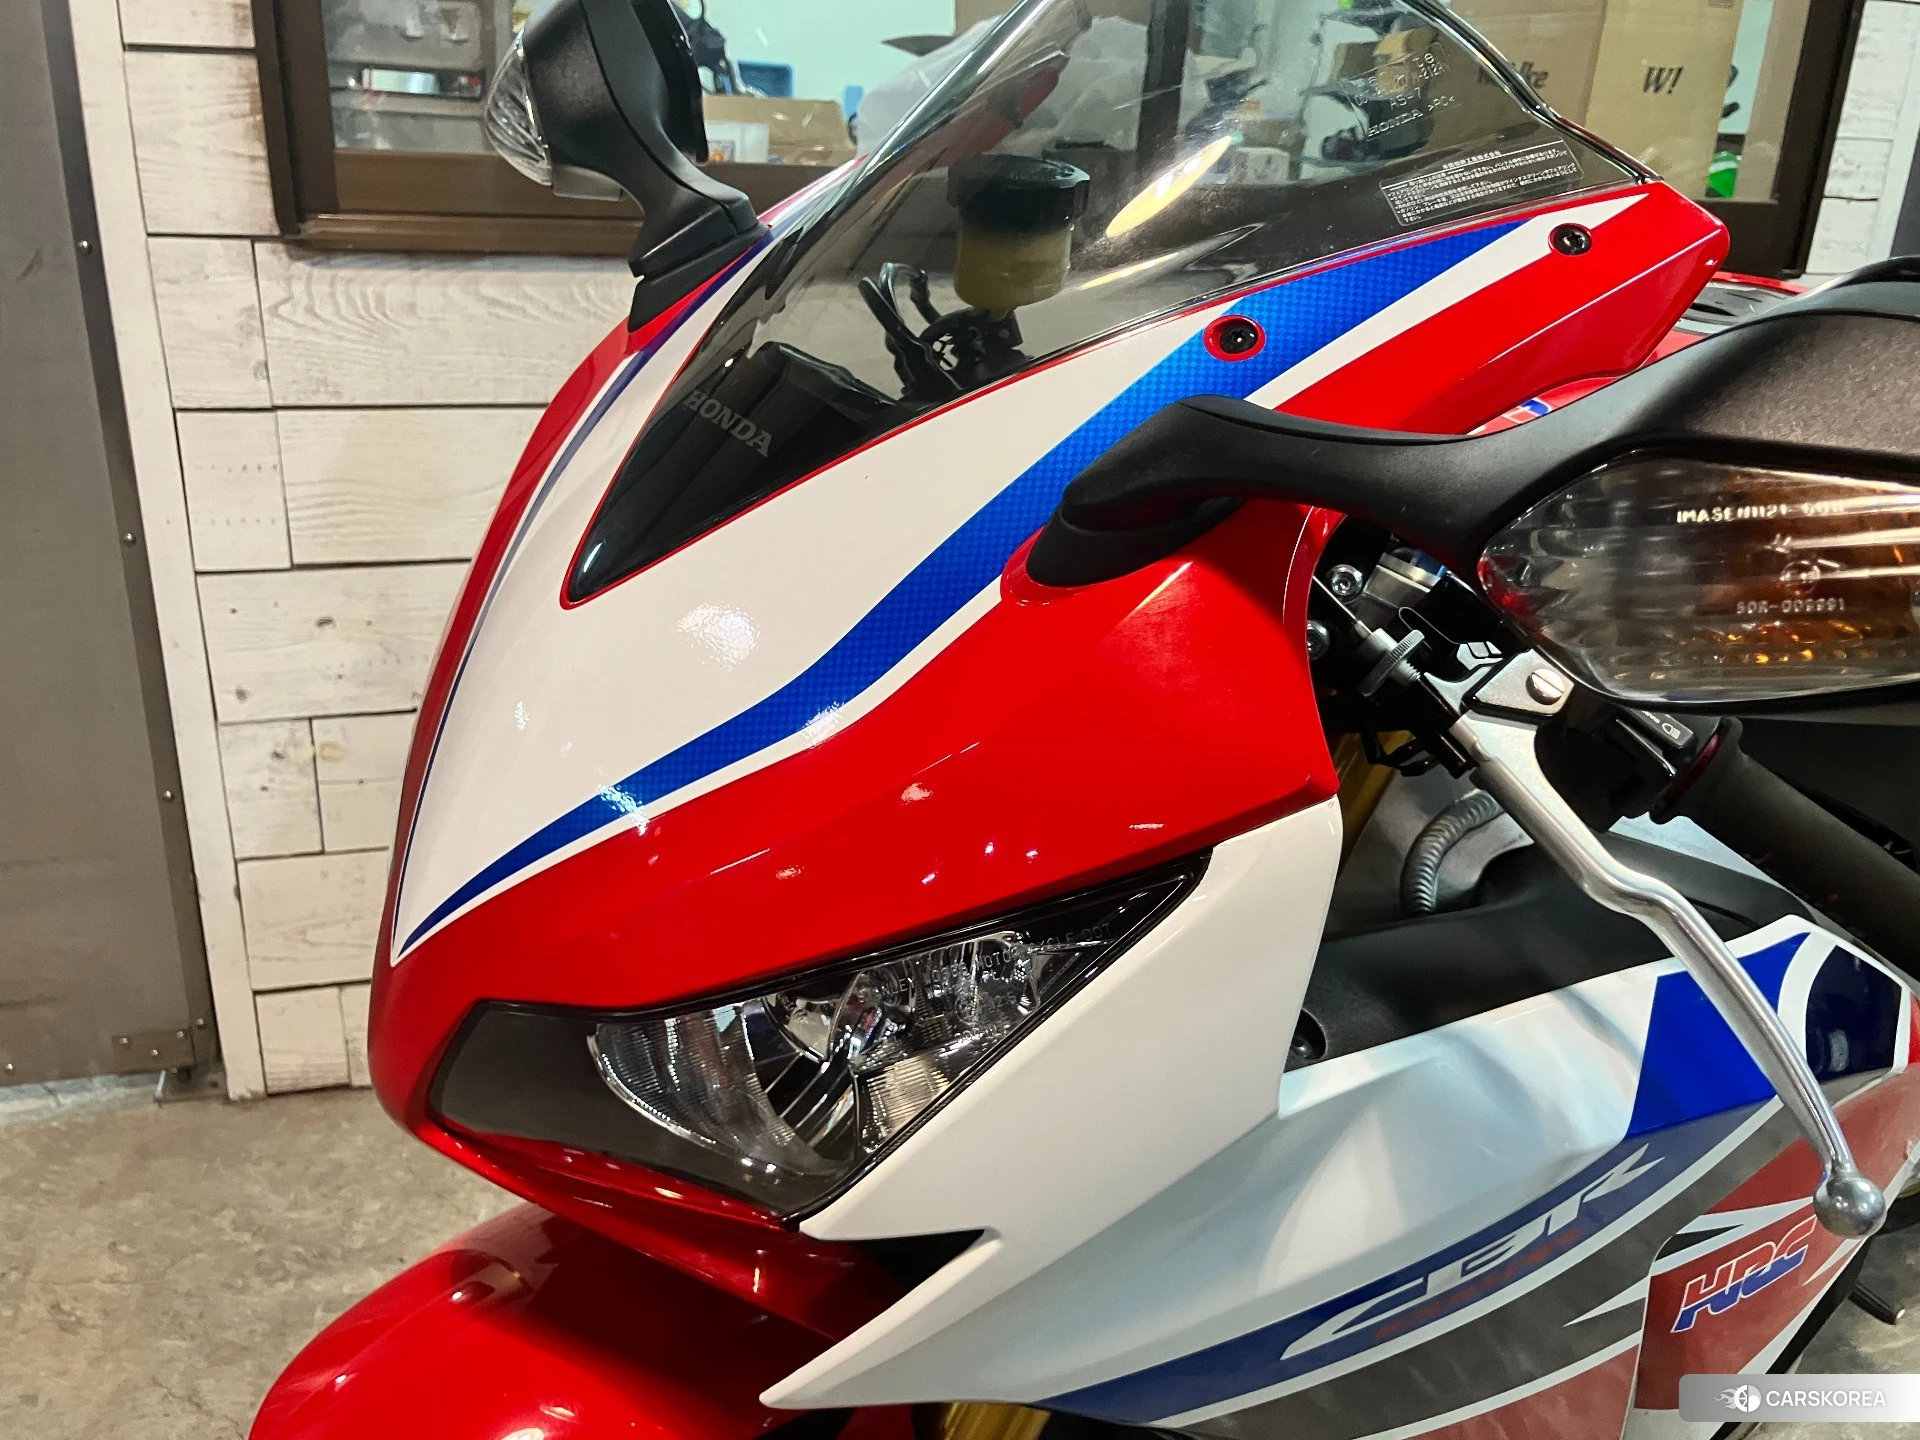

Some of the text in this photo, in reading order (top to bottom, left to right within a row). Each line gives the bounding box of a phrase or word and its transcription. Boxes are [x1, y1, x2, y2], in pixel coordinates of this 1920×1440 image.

[1641, 65, 1684, 96] W!
[682, 389, 772, 458] HONDA
[1279, 1143, 1664, 1360] CBR
[1671, 1214, 1818, 1334] HRC
